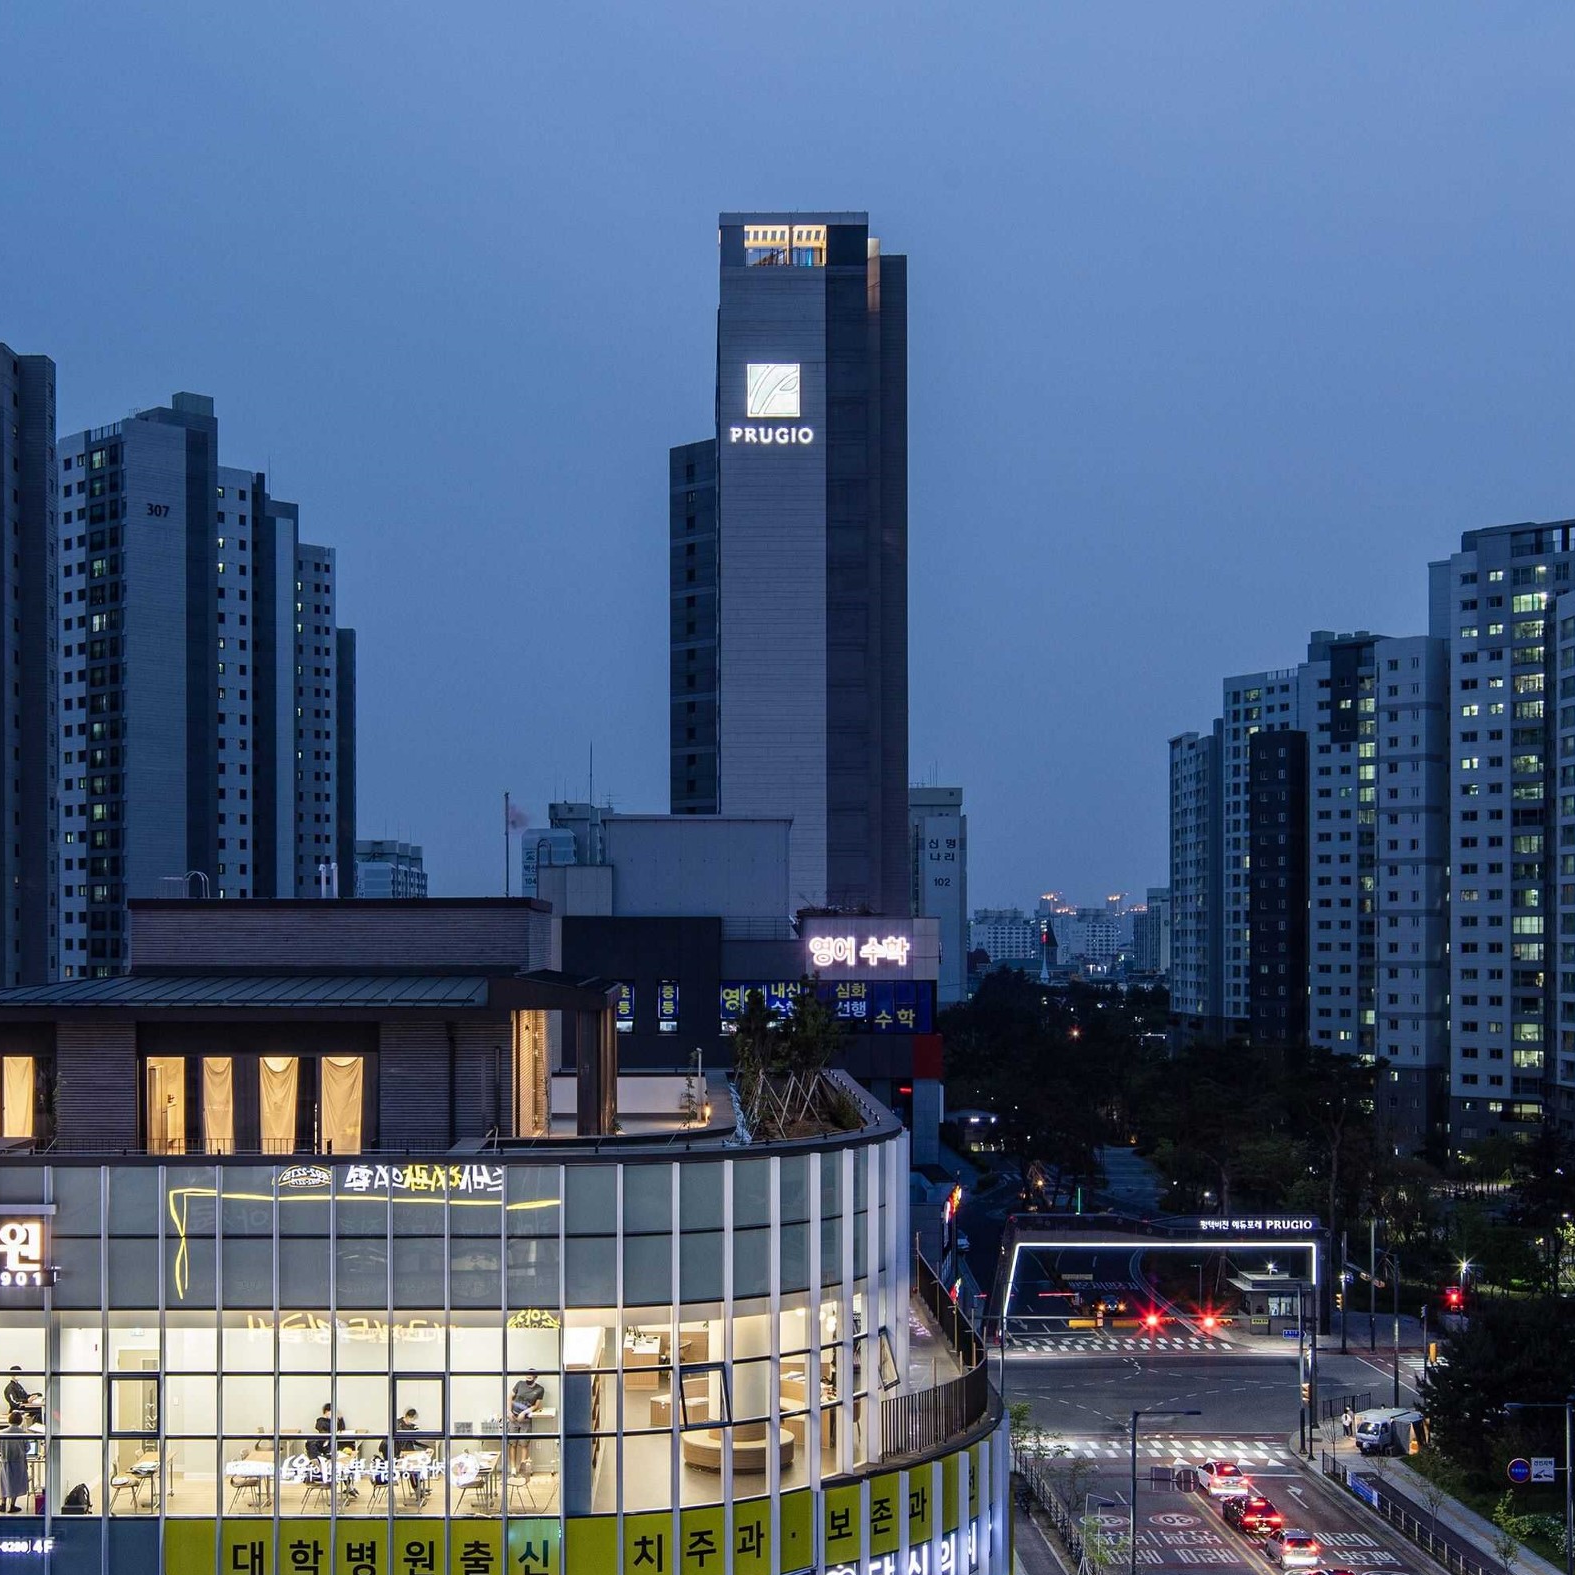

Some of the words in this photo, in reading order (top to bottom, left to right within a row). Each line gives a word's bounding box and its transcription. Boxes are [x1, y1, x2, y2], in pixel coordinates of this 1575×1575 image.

[730, 427, 813, 444] PRUGIO
[147, 503, 170, 518] 307
[934, 877, 951, 886] 102
[809, 937, 855, 966] 영어
[860, 937, 909, 966] 수학
[835, 983, 867, 999] 심화
[662, 984, 676, 1015] 중등
[874, 1008, 916, 1030] 수학
[1266, 1220, 1312, 1230] PRUGIO
[632, 1520, 765, 1573] 치주과
[827, 1486, 927, 1541] 보존과
[32, 1540, 53, 1554] 4F
[1313, 1532, 1379, 1548] 어린이
[1176, 1548, 1241, 1564] 어린이
